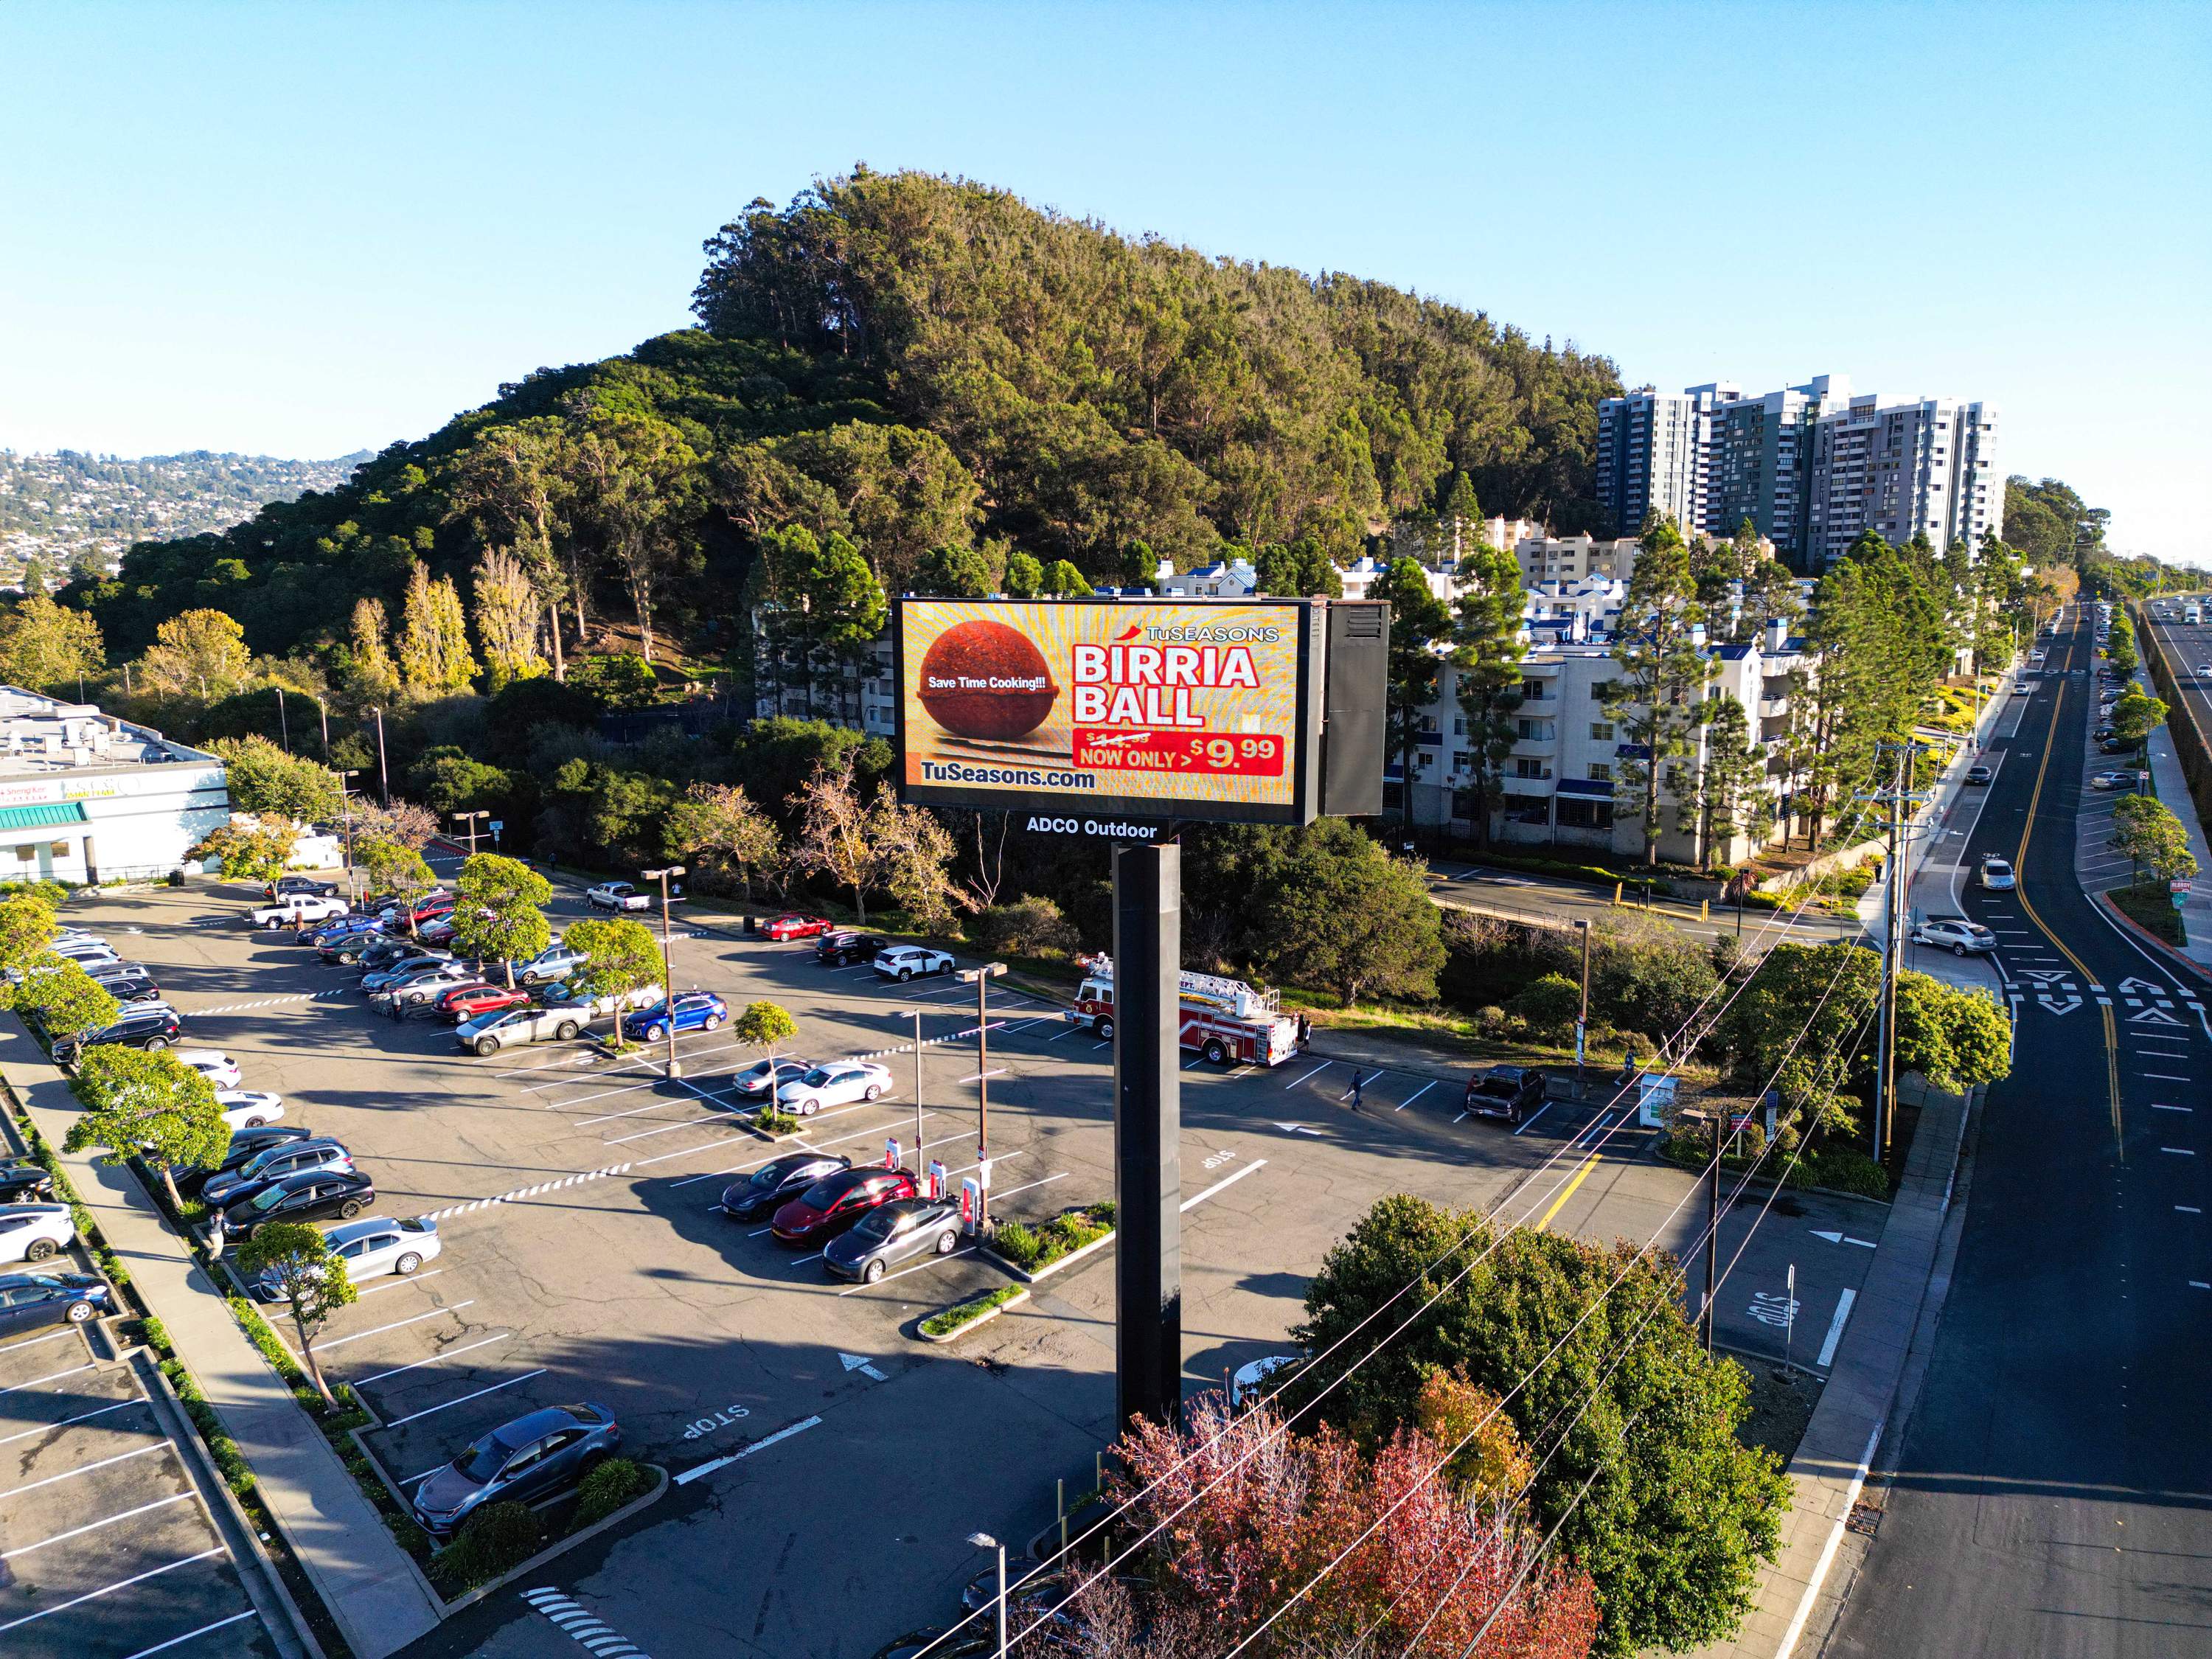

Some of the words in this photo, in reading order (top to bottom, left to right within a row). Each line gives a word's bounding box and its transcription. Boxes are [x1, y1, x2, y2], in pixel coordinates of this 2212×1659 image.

[1146, 626, 1279, 643] TuSEASONS
[1074, 644, 1260, 688] BIRRIA
[928, 677, 956, 689] Save
[958, 677, 987, 689] Time
[989, 677, 1046, 691] Cooking!!!
[1074, 686, 1205, 726] BALL
[1080, 748, 1122, 765] NOW
[1127, 750, 1177, 768] ONLY
[921, 761, 1096, 788] TuSeasons.com
[1026, 817, 1079, 834] ADCO
[1085, 820, 1158, 838] Outdoor
[1180, 981, 1194, 989] EPT.
[1200, 1150, 1236, 1169] STOP
[1746, 1292, 1801, 1327] STOP
[684, 1404, 750, 1439] STOP
